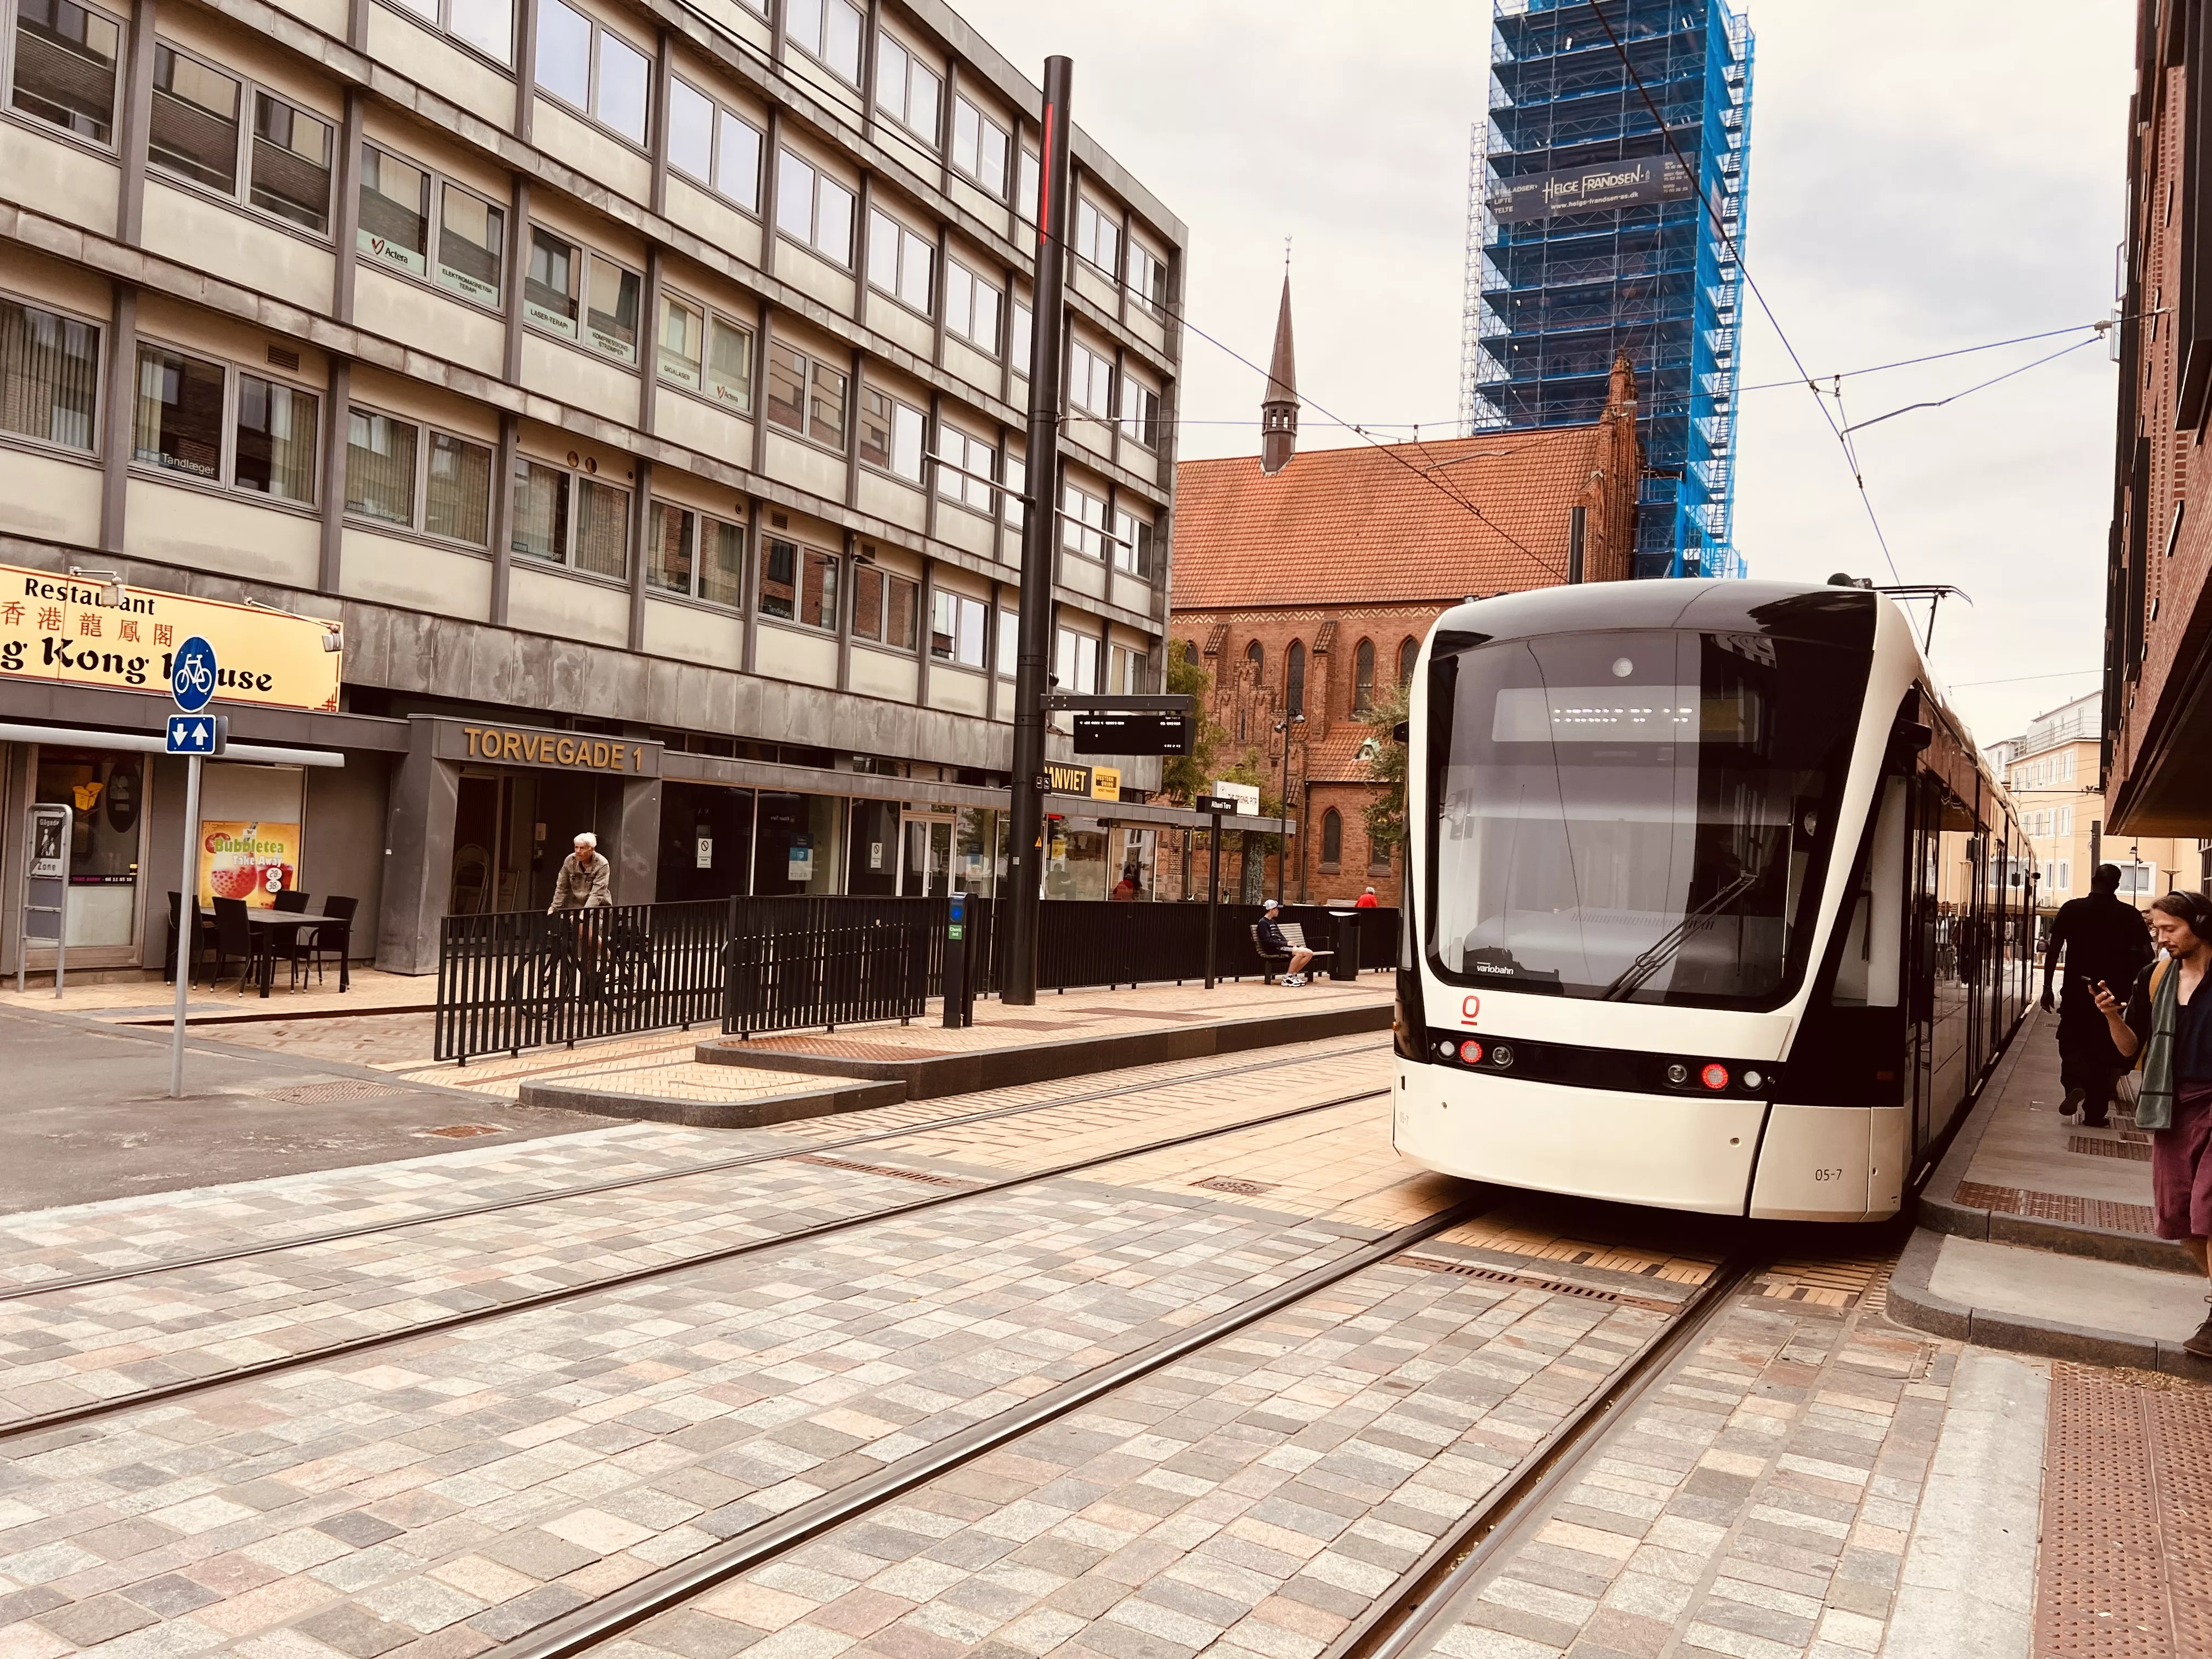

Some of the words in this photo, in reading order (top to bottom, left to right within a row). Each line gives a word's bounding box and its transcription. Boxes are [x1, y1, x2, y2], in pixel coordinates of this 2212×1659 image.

[1494, 184, 1535, 195] STILLADSER
[1542, 177, 1579, 204] HELGE
[1581, 163, 1640, 199] FRANDSEN
[1494, 196, 1513, 205] LIFTE
[385, 247, 408, 263] Actera
[442, 268, 493, 294] ELEKTROMAGNETISK
[459, 283, 477, 294] TERAPI
[531, 308, 568, 330] LASER-TERAPI
[664, 365, 690, 381] GIGALASER
[162, 453, 215, 475] Tandlæger
[1, 601, 173, 647] 香港龍鳳閣
[42, 636, 149, 685] Kong
[465, 727, 625, 770] TORVEGADE
[633, 747, 642, 771] 1
[1211, 800, 1223, 809] Albani
[215, 838, 284, 853] Bubbletea
[37, 862, 56, 871] Zone
[233, 854, 255, 865] Take
[257, 855, 283, 867] Away
[1477, 964, 1514, 975] variobahn
[1815, 1169, 1842, 1181] 05-7
